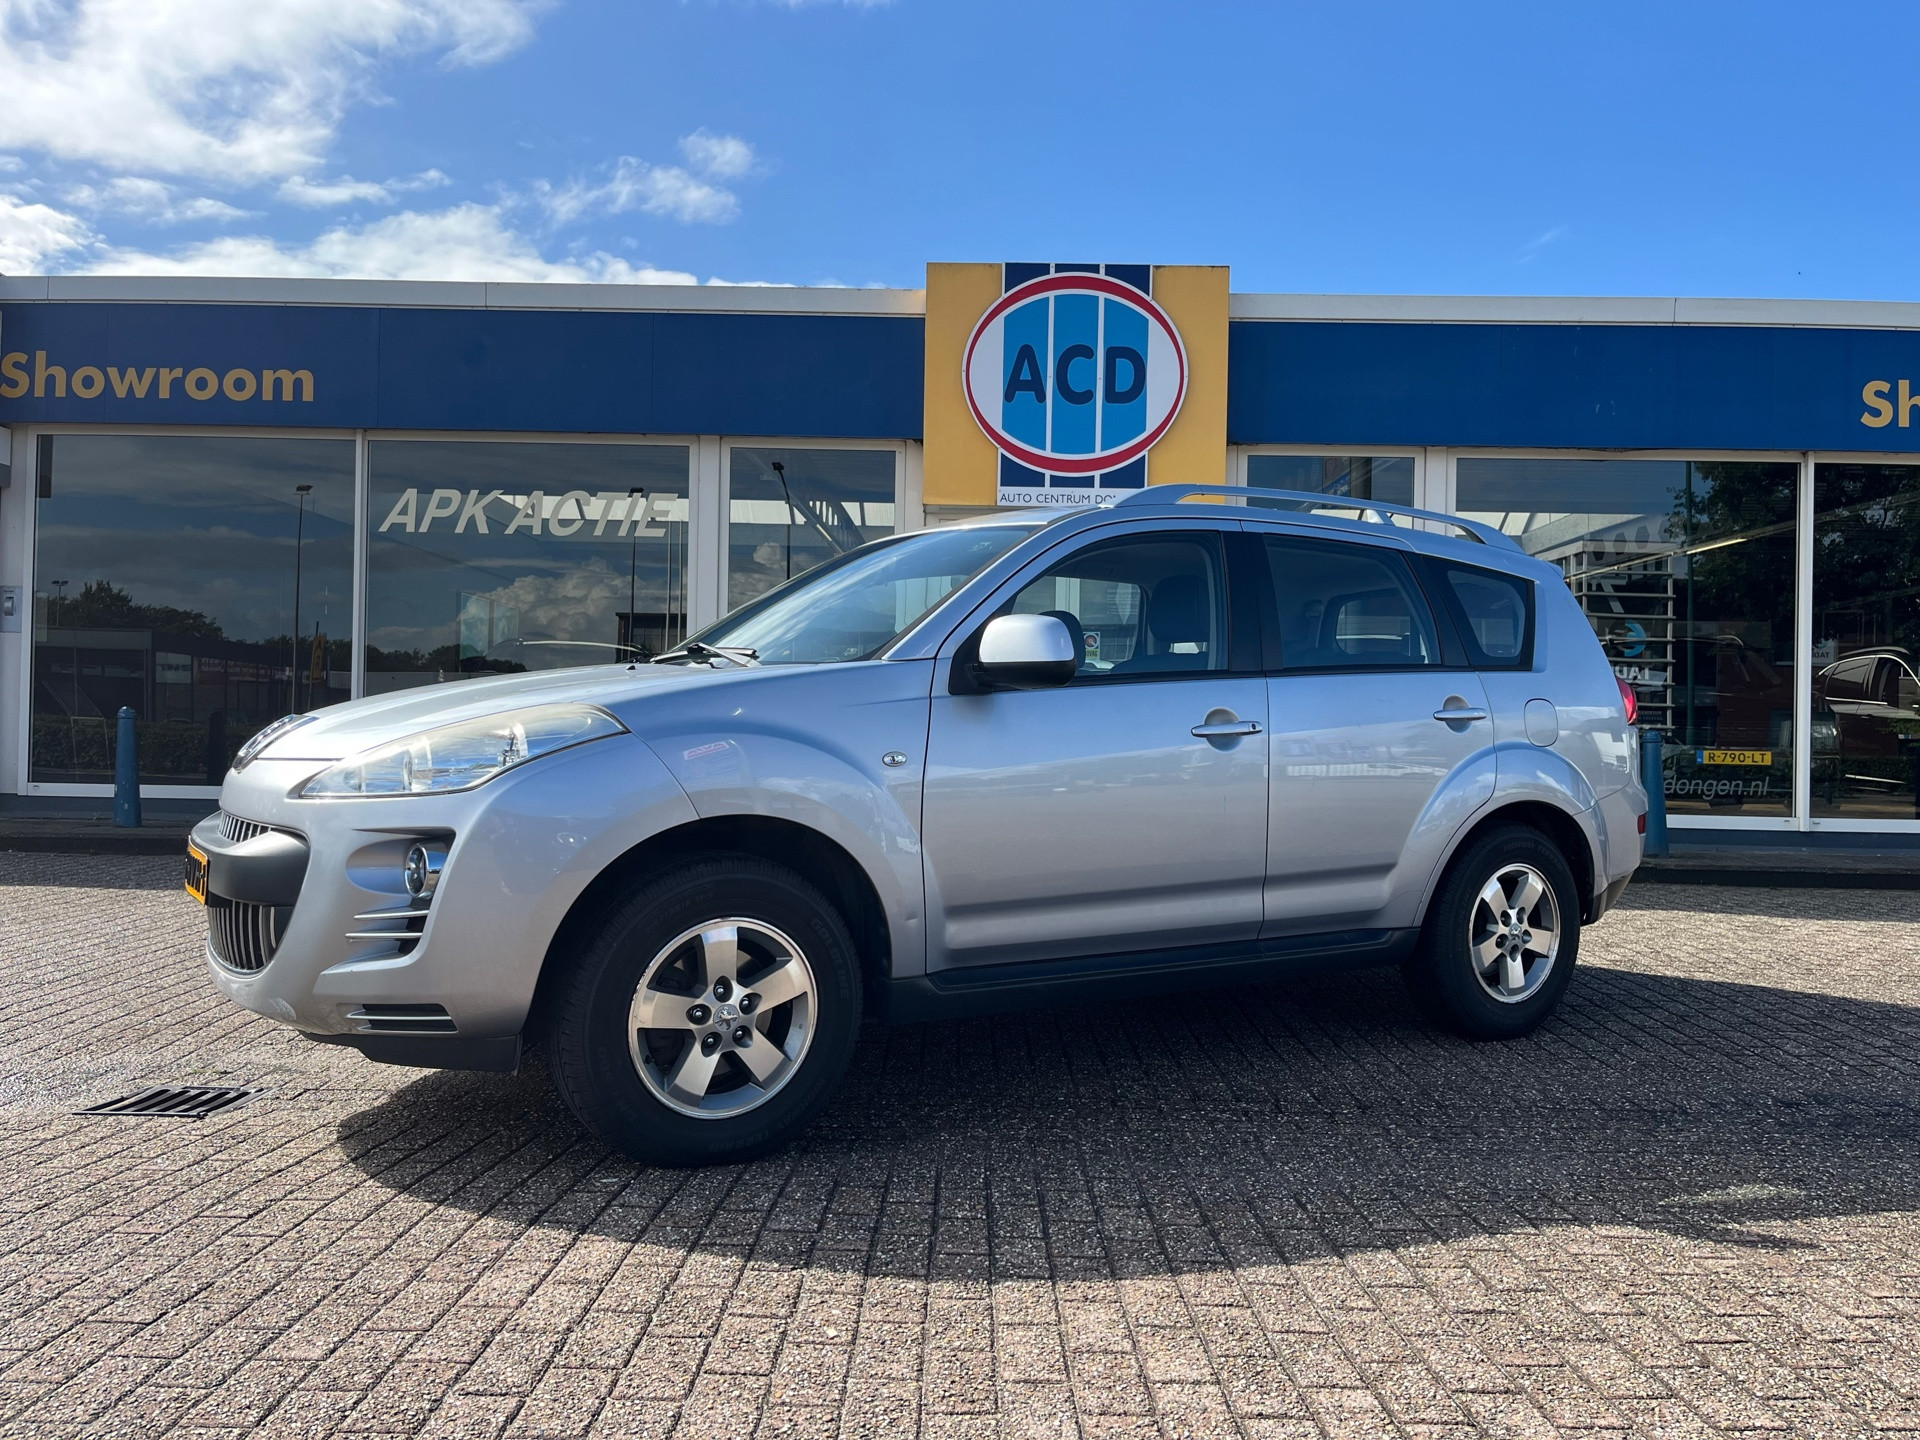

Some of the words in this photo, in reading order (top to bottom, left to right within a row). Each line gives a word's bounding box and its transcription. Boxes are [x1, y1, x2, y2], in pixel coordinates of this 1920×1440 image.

[0, 350, 314, 401] Showroom
[1004, 343, 1146, 405] ACD
[378, 488, 504, 534] APK
[504, 490, 678, 537] ACTIE
[1000, 493, 1032, 503] AUTO
[1036, 494, 1091, 504] CENTRUM
[1095, 494, 1116, 505] DO
[1708, 752, 1766, 763] R-790-LT
[1664, 774, 1770, 800] dongen.nl
